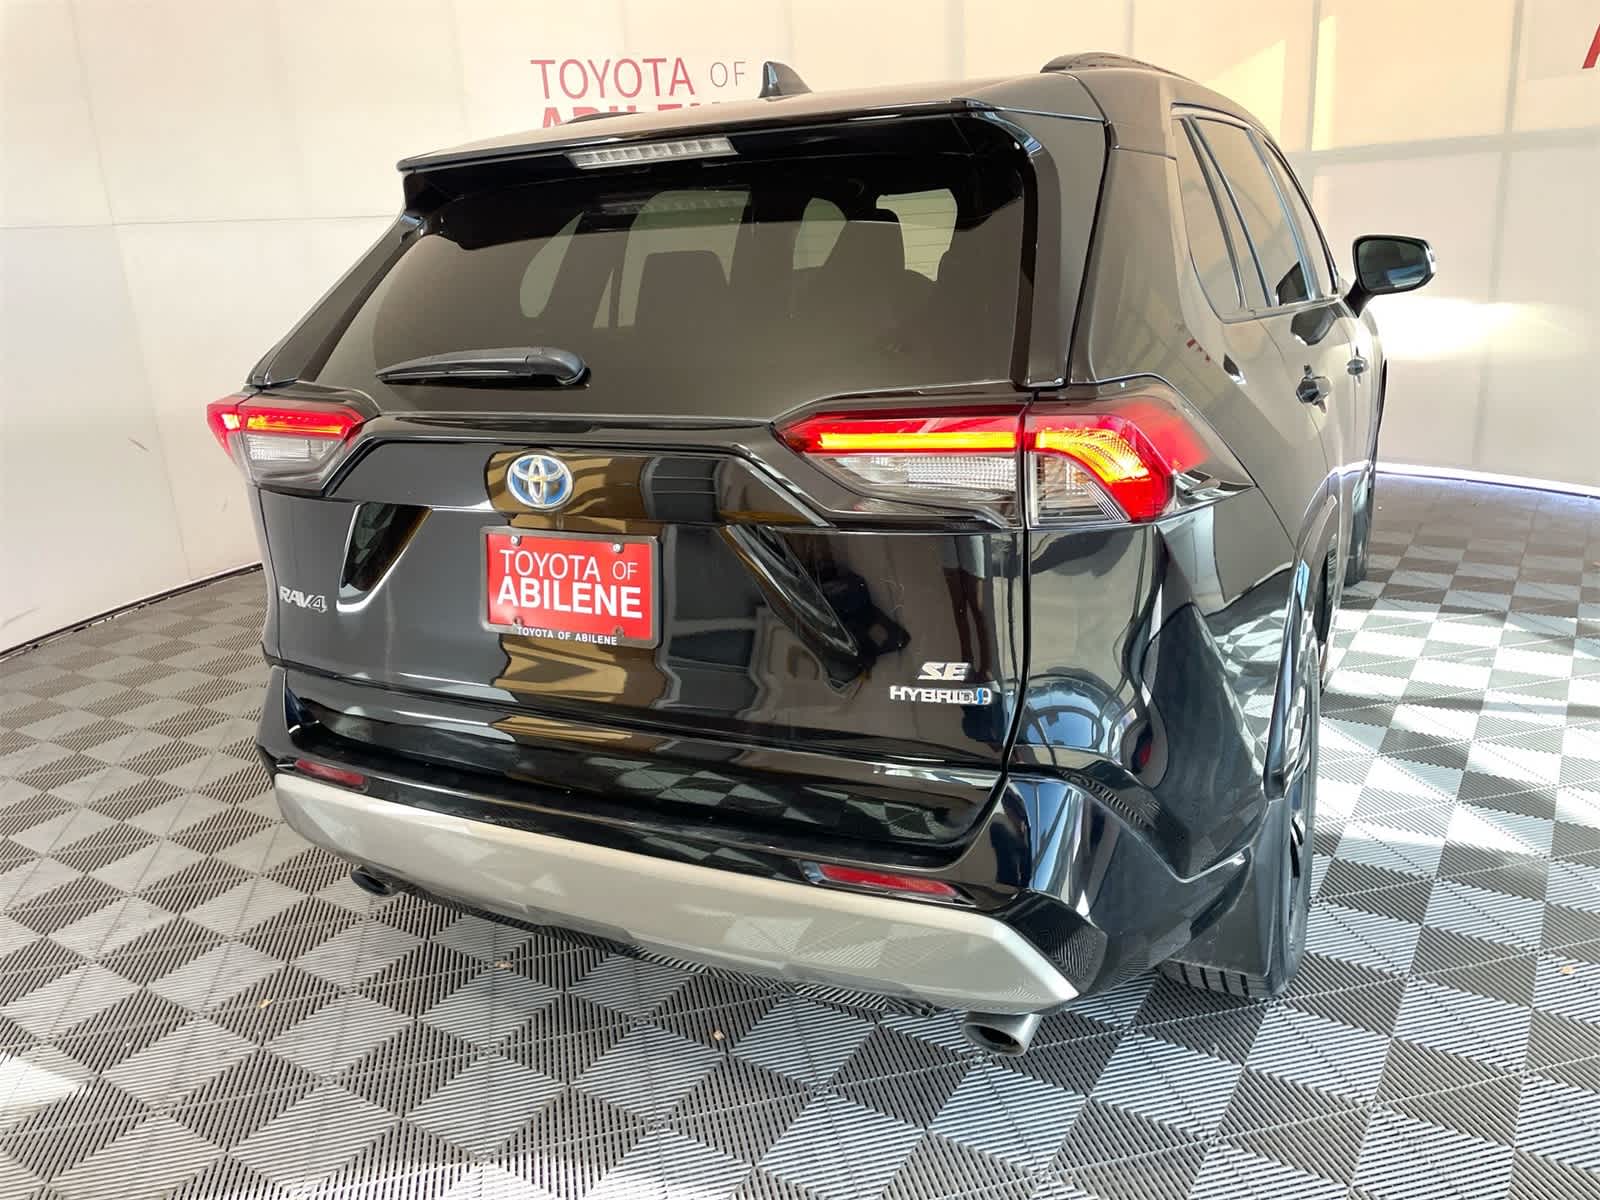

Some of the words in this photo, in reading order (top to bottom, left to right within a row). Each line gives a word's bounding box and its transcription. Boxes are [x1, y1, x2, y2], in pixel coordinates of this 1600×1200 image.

[530, 57, 695, 99] TOYOTA
[710, 61, 746, 87] OF
[500, 549, 601, 582] TOYOTA
[612, 560, 638, 580] OF
[279, 585, 328, 613] RAV4
[497, 575, 643, 619] ABILENE
[518, 626, 554, 639] TOYOTA
[558, 631, 571, 640] OF
[575, 633, 617, 646] ABILENE
[918, 661, 969, 681] SE
[889, 685, 976, 704] HYBRID
